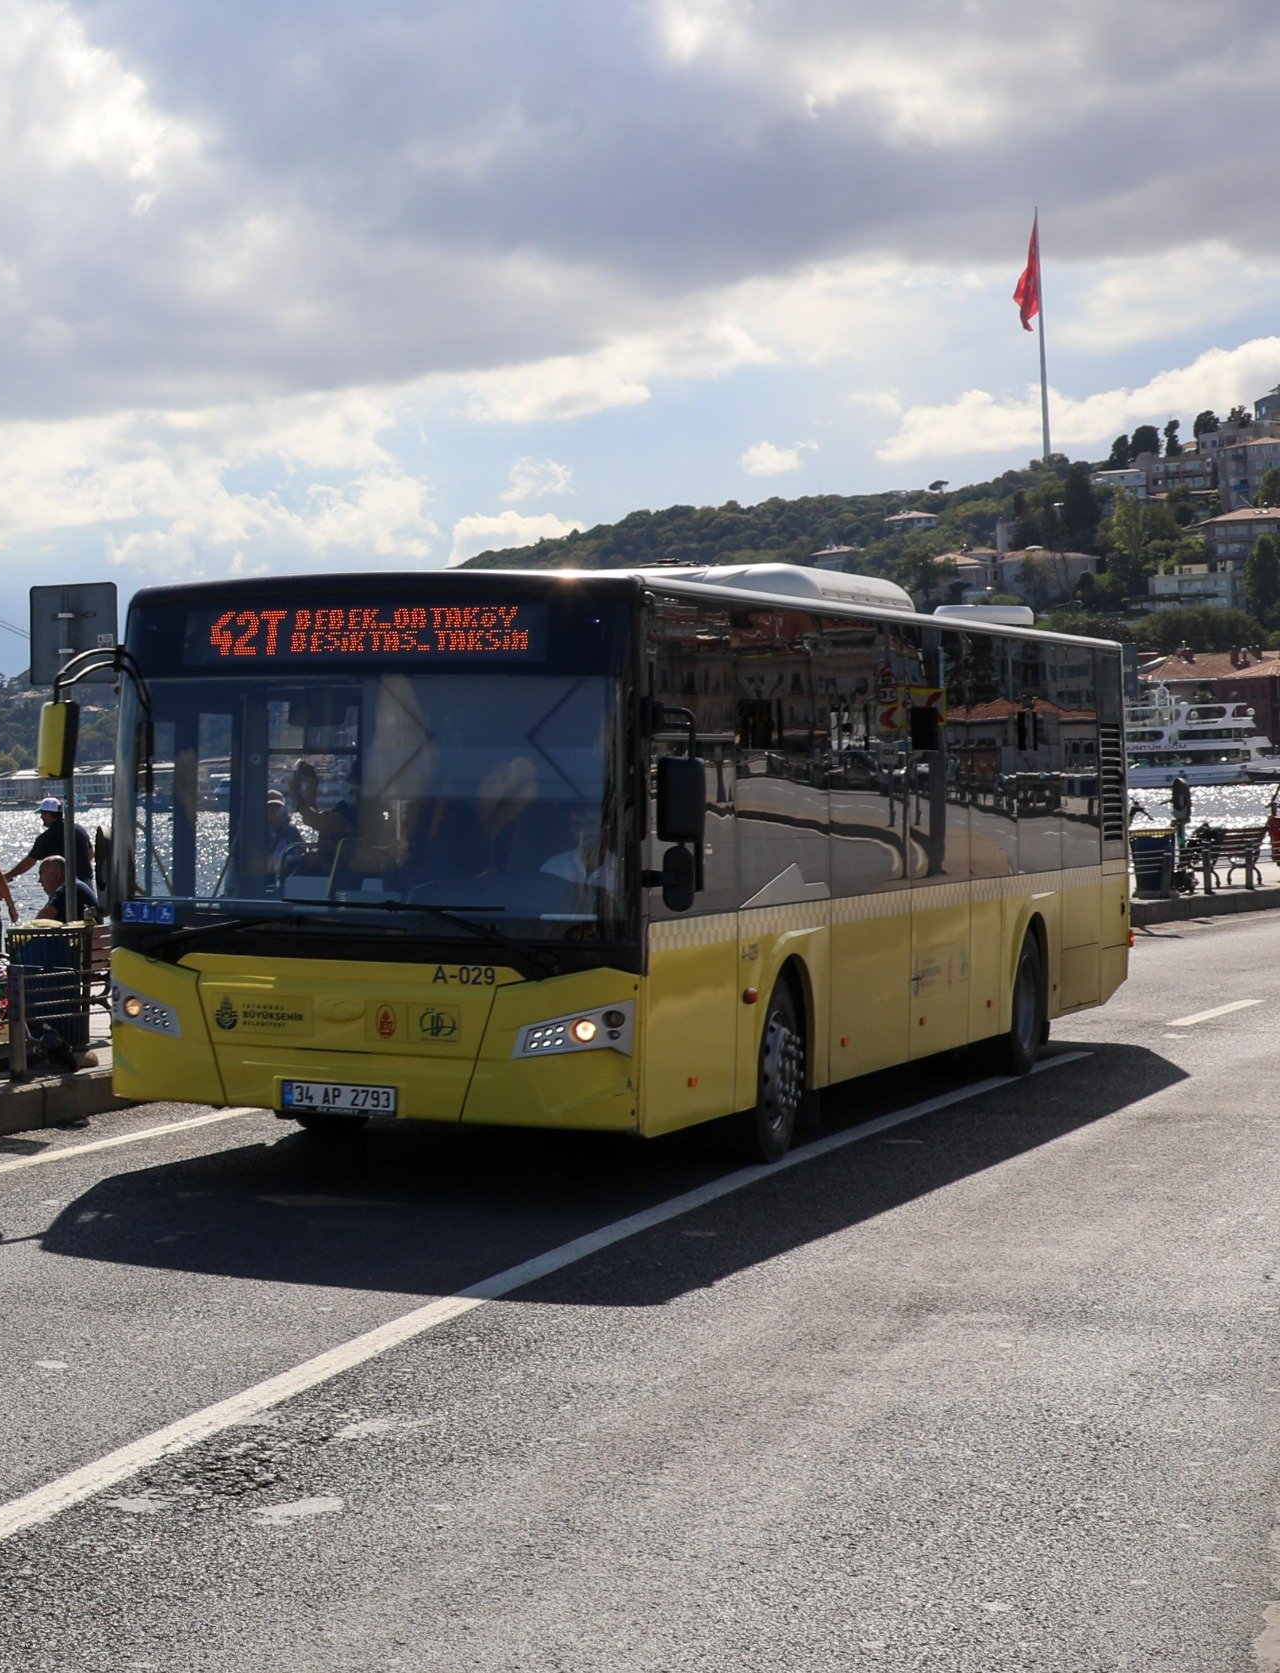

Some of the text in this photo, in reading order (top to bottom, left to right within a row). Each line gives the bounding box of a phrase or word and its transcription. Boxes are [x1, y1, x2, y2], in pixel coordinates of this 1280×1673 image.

[210, 610, 287, 655] 42T
[432, 965, 496, 985] A-029
[294, 1085, 314, 1104] 34
[322, 1087, 342, 1106] AP
[350, 1088, 391, 1109] 2793
